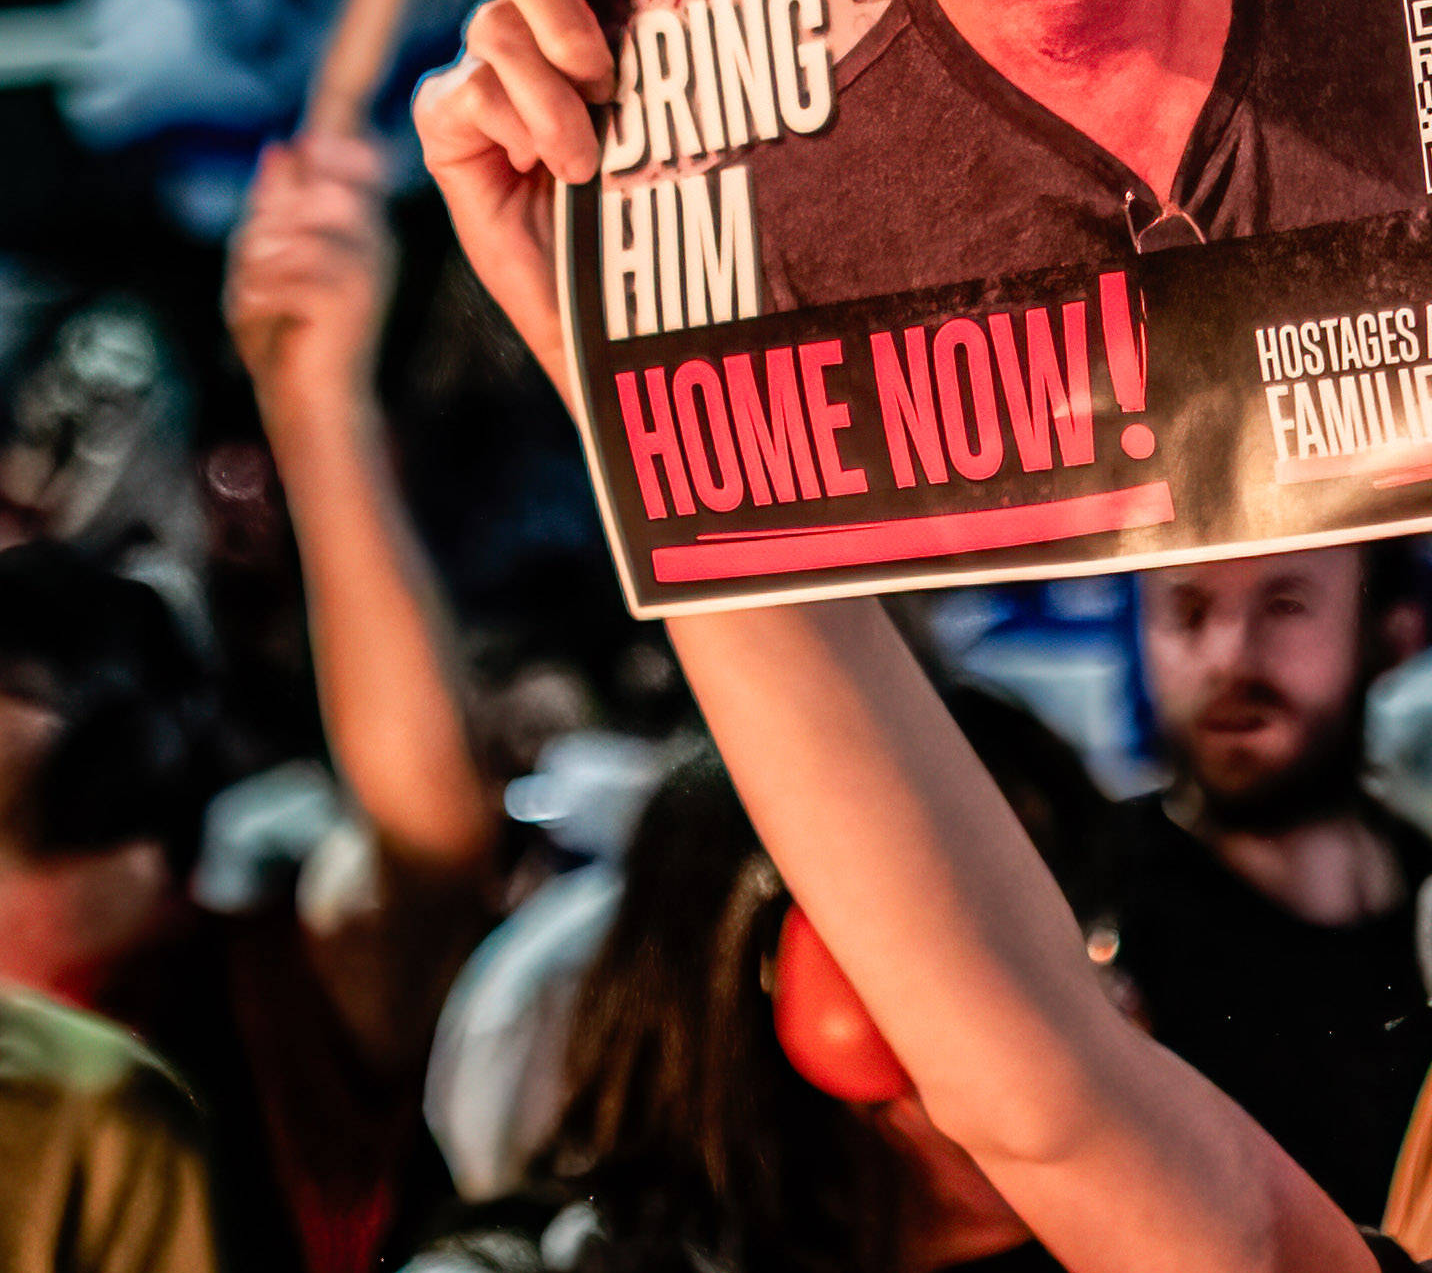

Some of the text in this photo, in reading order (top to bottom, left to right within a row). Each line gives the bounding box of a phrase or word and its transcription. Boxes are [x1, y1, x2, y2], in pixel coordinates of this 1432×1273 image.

[601, 165, 761, 341] HIM
[614, 270, 1156, 520] HOME NOW!
[1255, 307, 1421, 382] HOSTAGES
